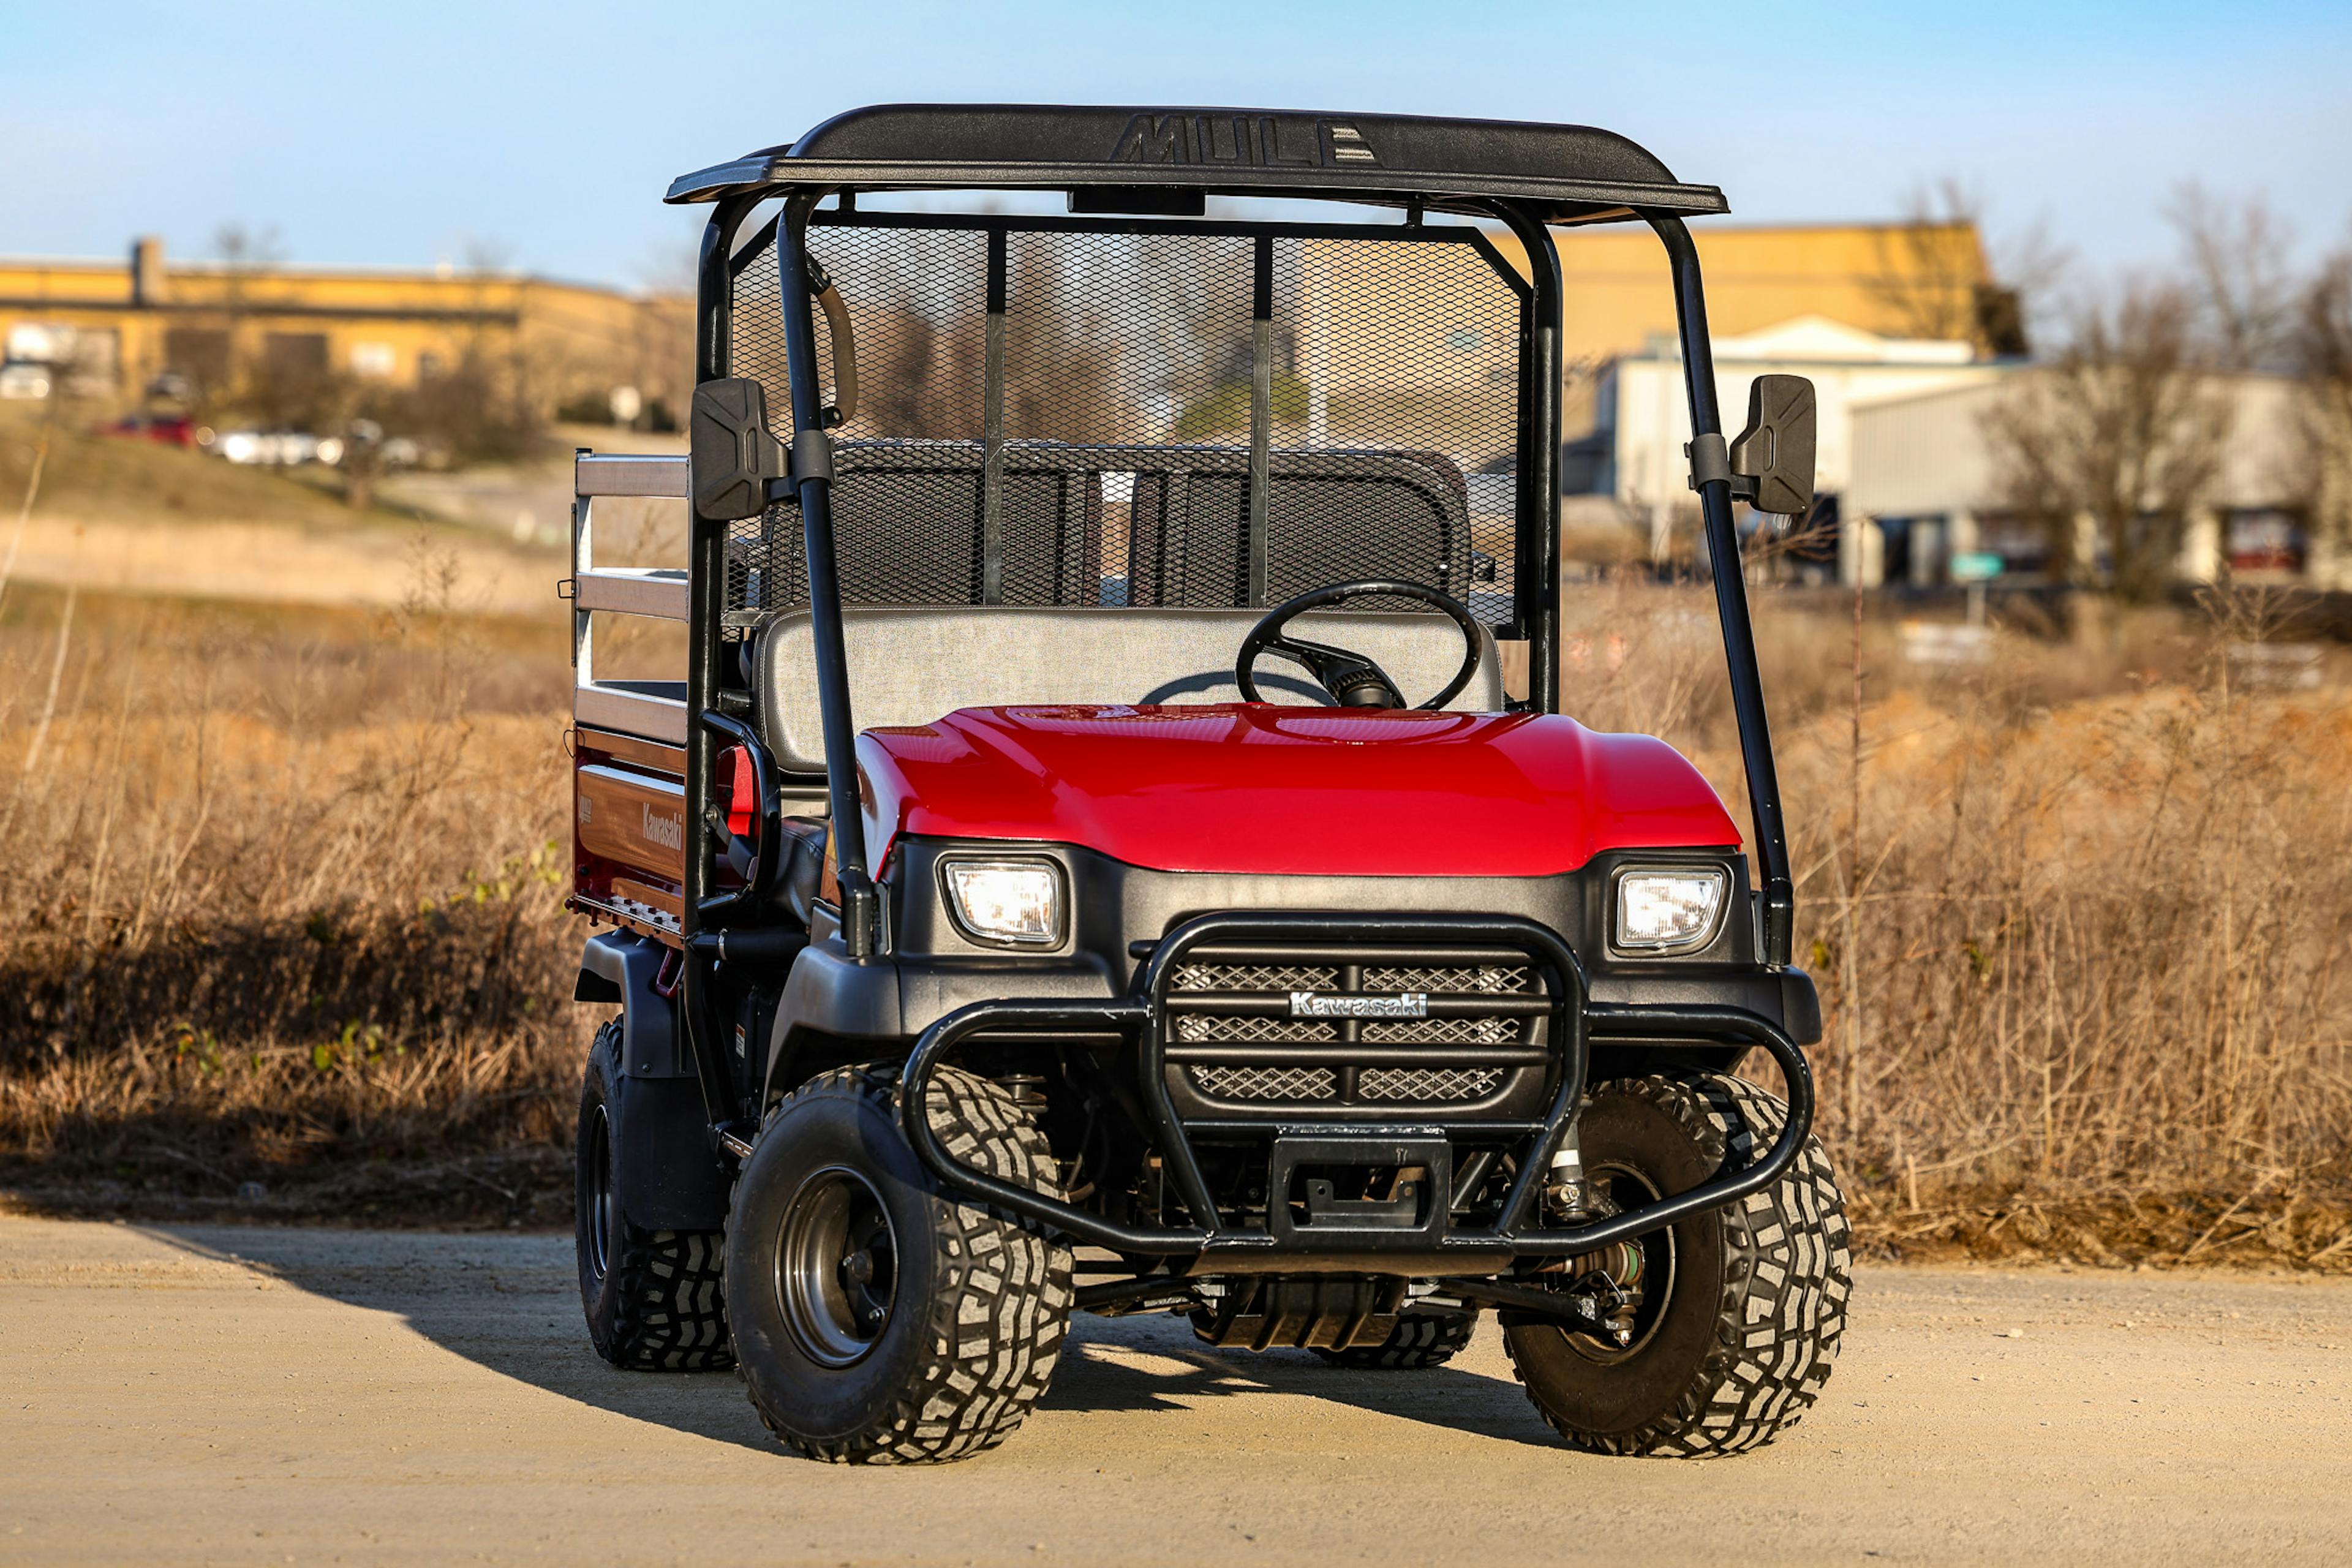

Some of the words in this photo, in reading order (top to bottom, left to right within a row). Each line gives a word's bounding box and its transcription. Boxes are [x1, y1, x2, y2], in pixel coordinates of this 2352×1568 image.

[1109, 113, 1384, 168] MULE
[643, 802, 682, 851] Kawasaki
[1290, 992, 1428, 1017] Kawasaki
